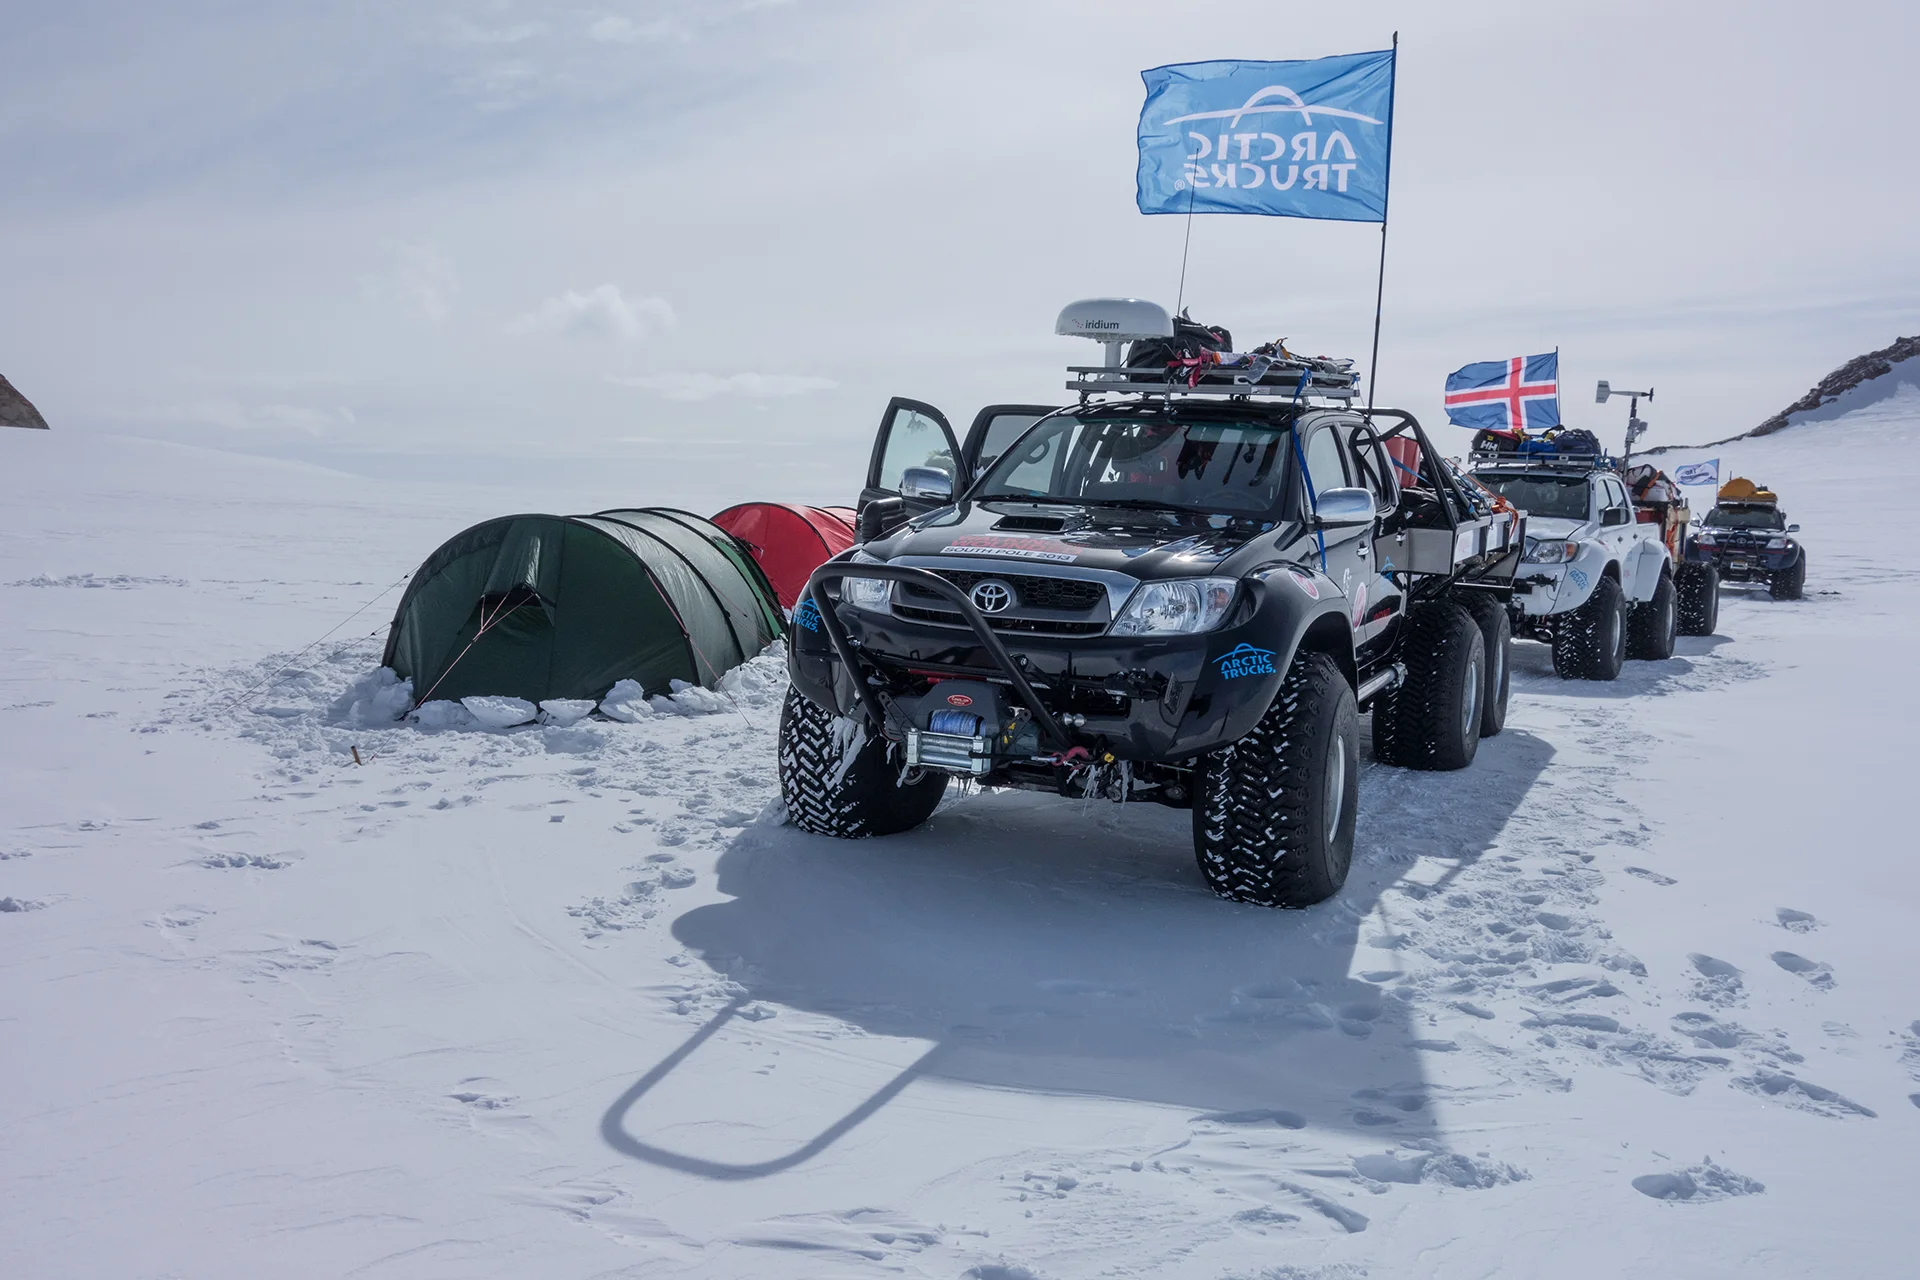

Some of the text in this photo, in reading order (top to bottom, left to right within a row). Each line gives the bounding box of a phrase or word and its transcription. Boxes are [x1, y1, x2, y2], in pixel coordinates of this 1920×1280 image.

[1085, 320, 1119, 329] iridium
[1480, 440, 1498, 451] HH
[944, 546, 1071, 561] SOUTH POLE 2013
[1221, 653, 1271, 671] ARCTIC
